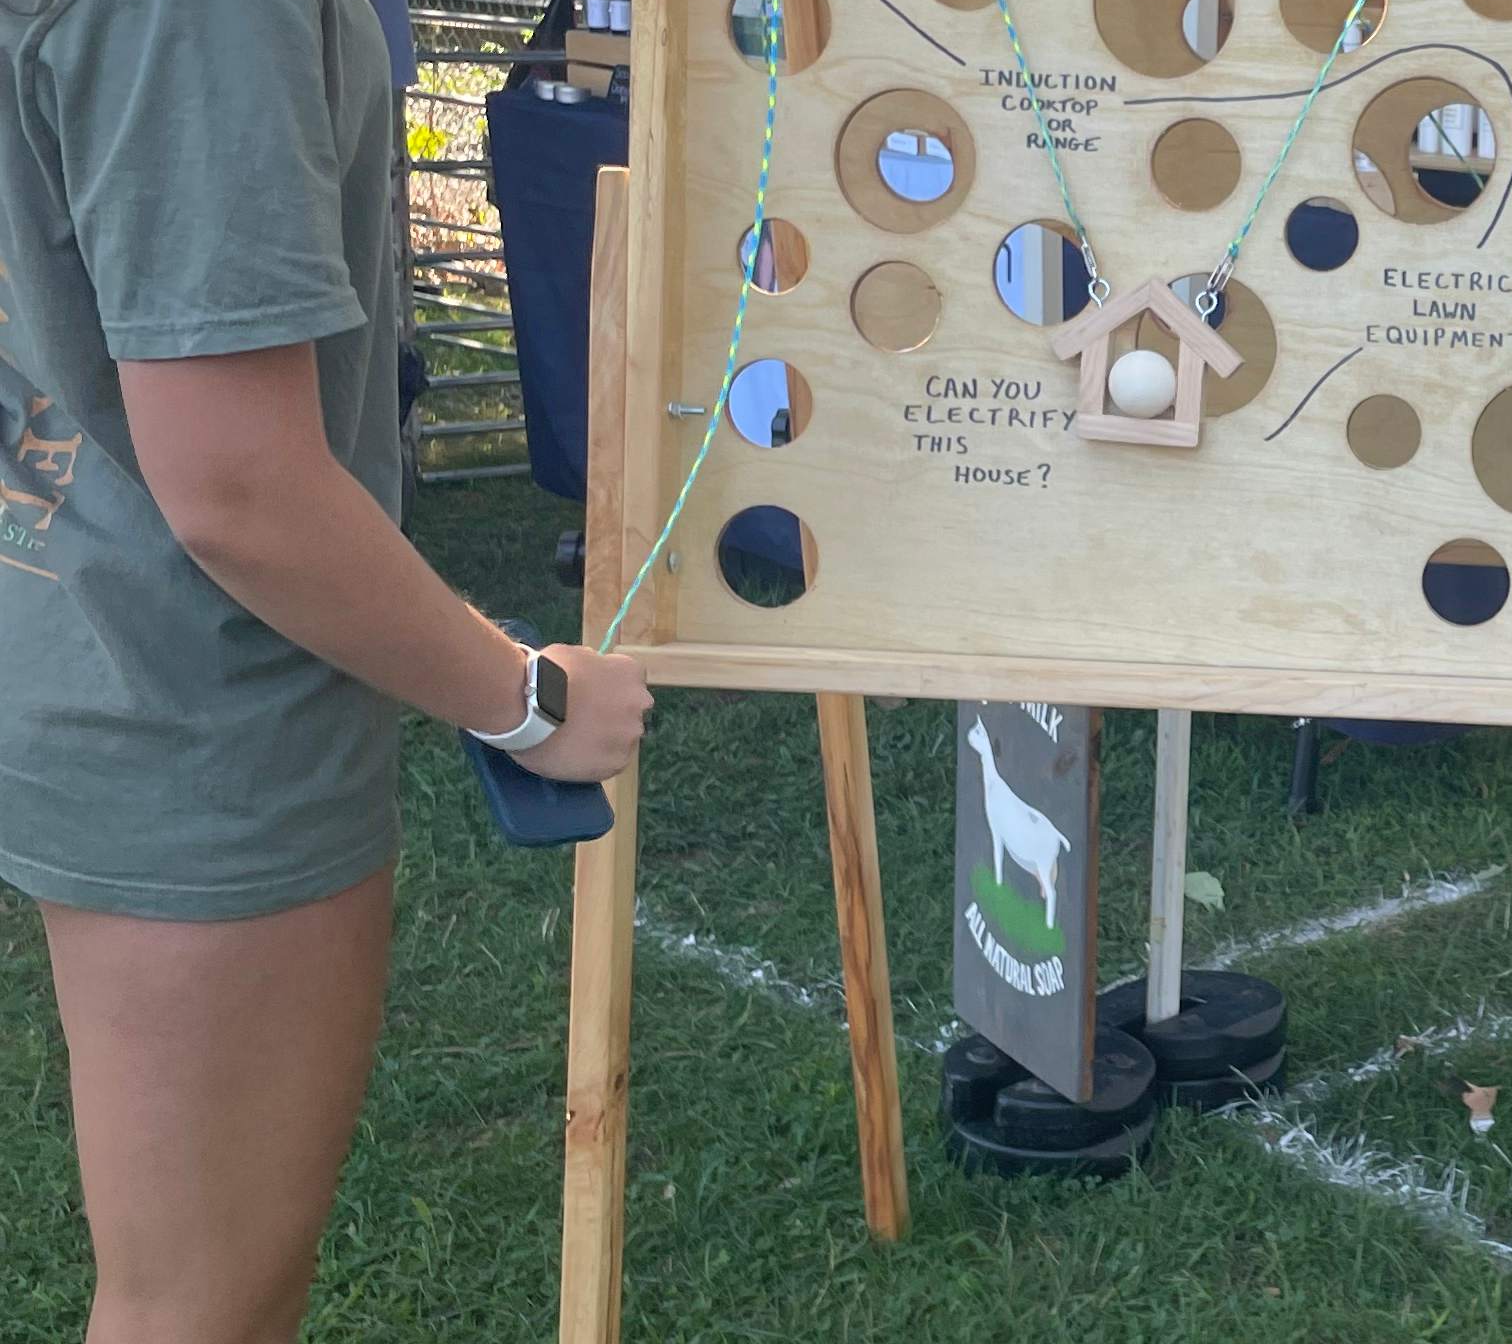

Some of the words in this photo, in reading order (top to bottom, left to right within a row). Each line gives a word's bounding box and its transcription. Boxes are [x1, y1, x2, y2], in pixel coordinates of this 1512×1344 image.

[1001, 94, 1098, 116] COOKTOP
[1048, 118, 1076, 133] OR
[1384, 268, 1512, 293] ELECTRIC
[1413, 299, 1477, 321] LAWN
[926, 375, 978, 399] CAN
[991, 379, 1042, 400] YOU
[904, 405, 1077, 431] ELECTRIFY
[913, 434, 969, 455] THIS
[954, 463, 1052, 489] HOUSE?
[964, 901, 986, 950] ALL
[983, 931, 1036, 996] NATURAL
[1033, 955, 1065, 996] SOAP
